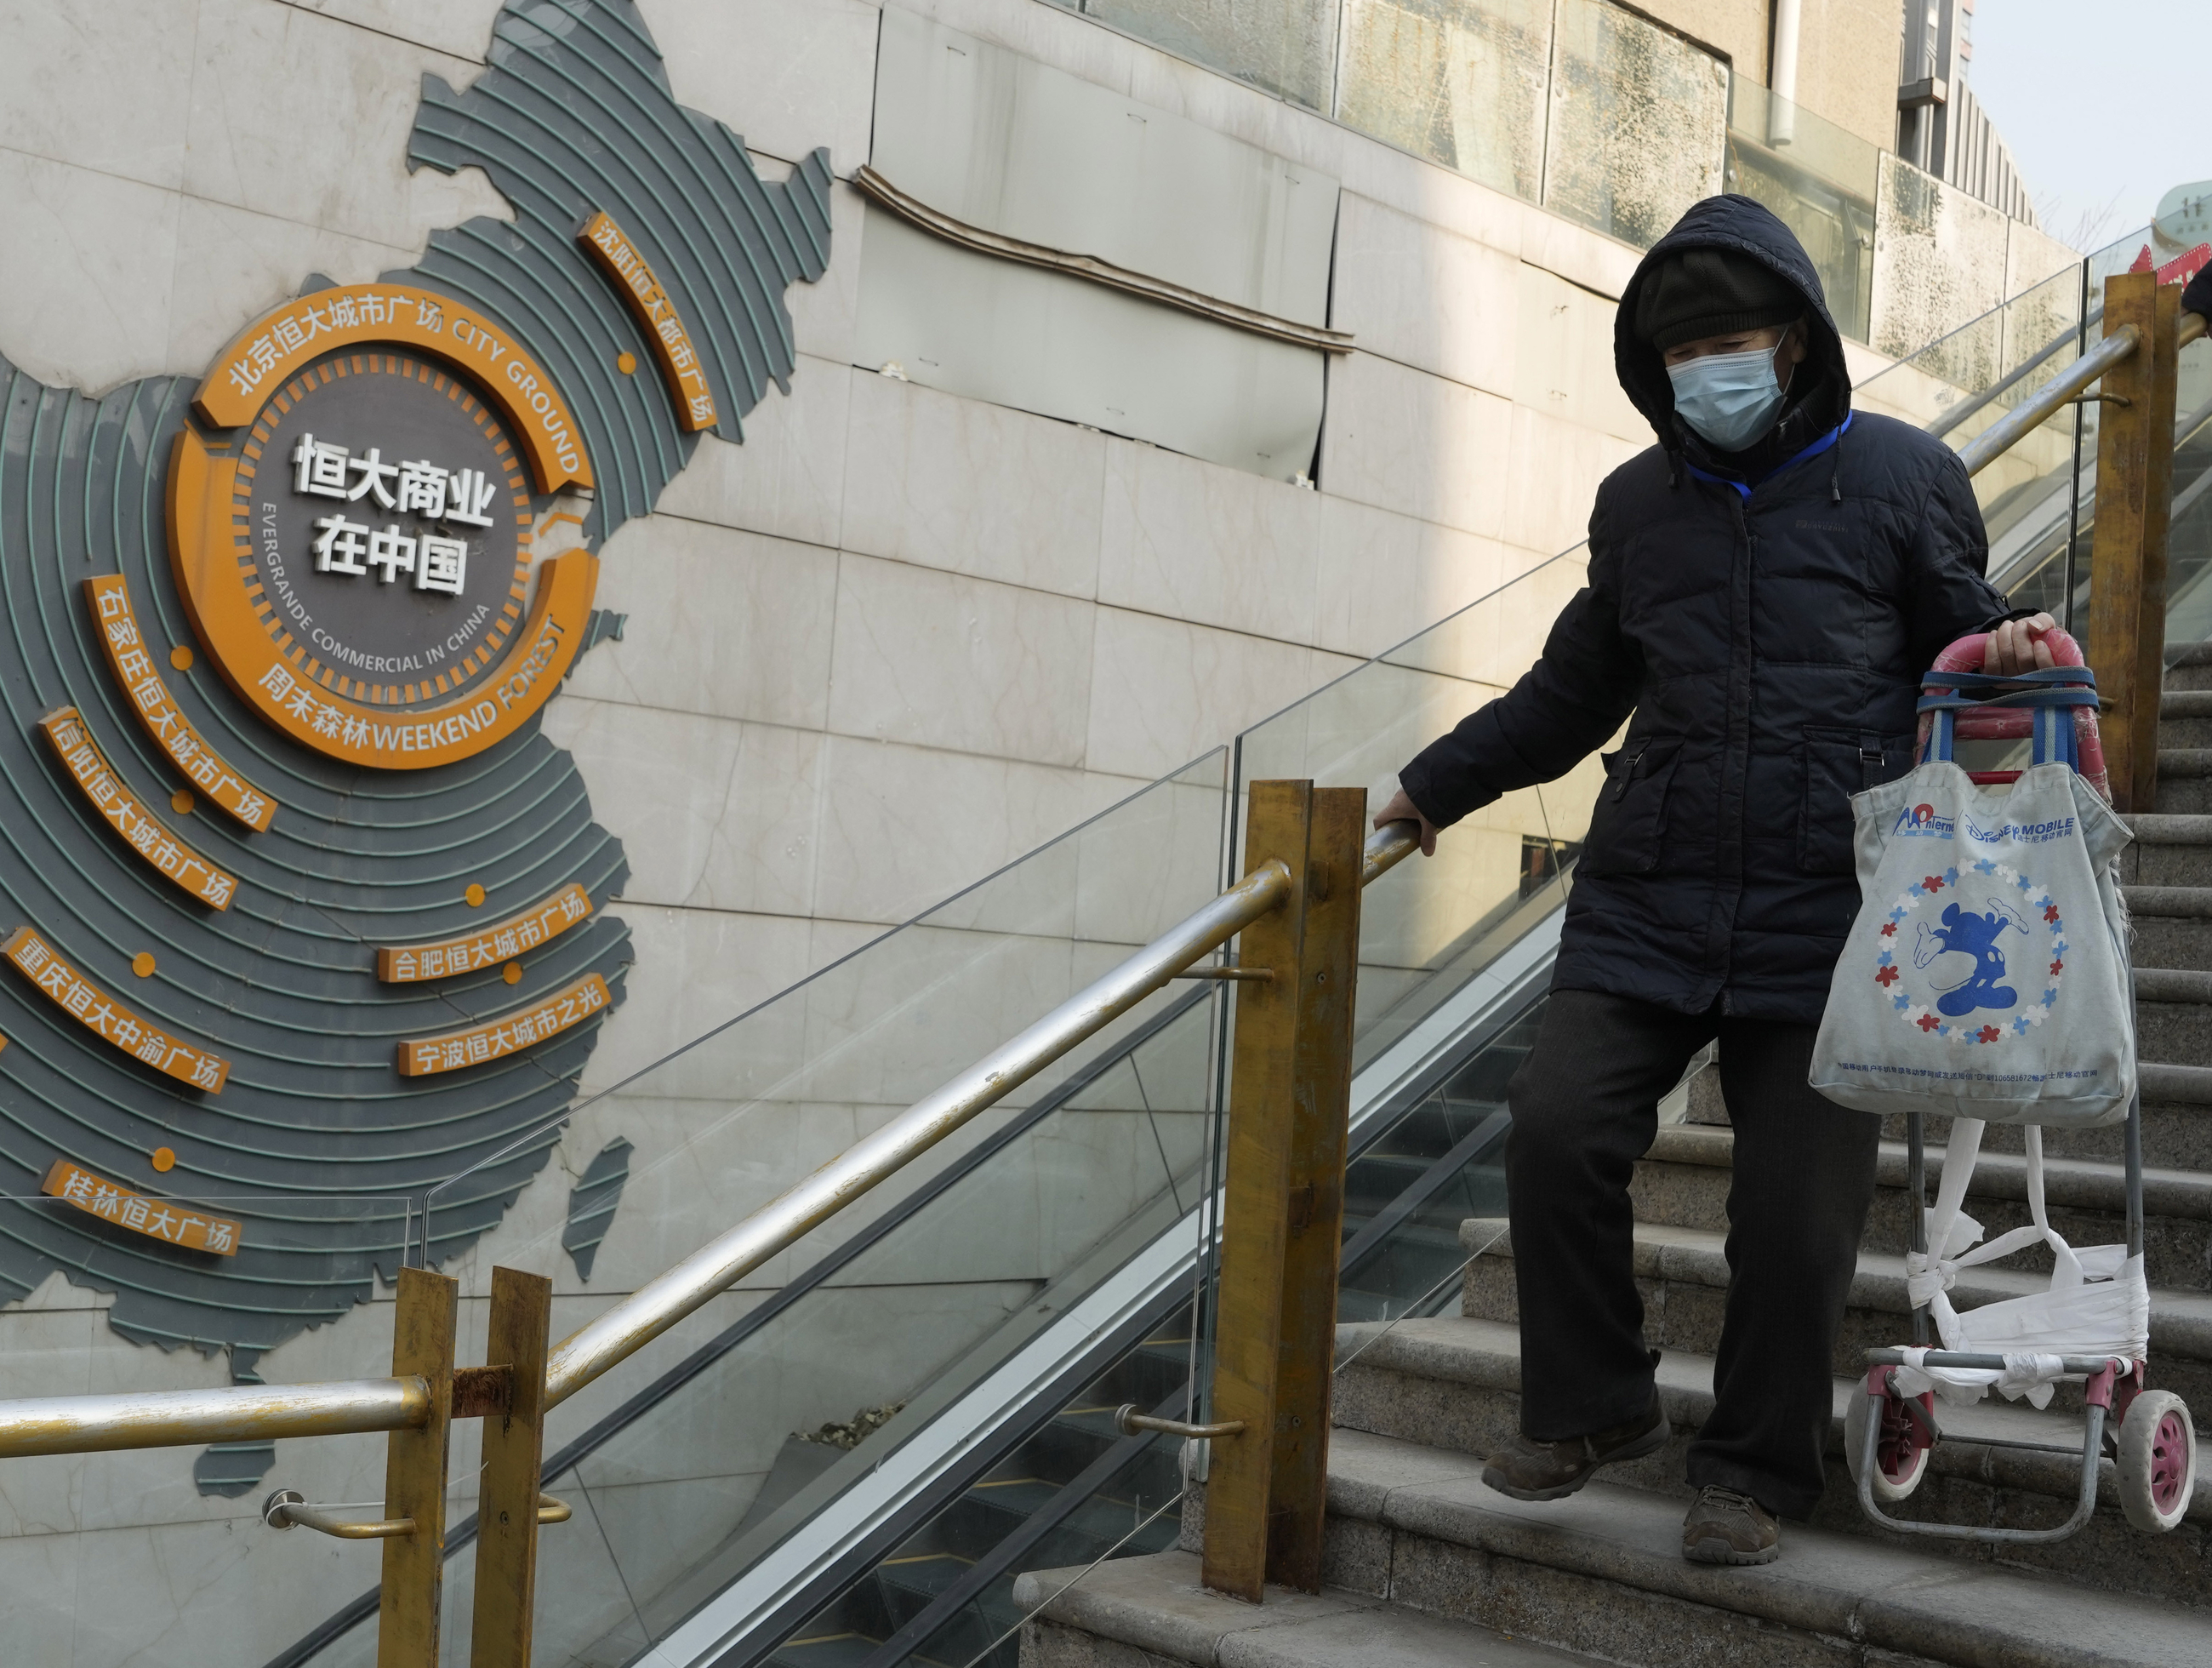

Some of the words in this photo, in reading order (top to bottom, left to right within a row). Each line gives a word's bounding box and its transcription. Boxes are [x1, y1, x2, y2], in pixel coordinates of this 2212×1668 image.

[229, 293, 443, 397] 北京恒大城市广场
[453, 317, 507, 363] CITY
[505, 359, 579, 475] GROUND
[593, 220, 713, 422] 沈阳恒大都市广场
[291, 432, 497, 528] 恒大商业
[261, 502, 313, 631] EVERGRANDE
[311, 626, 424, 673] COMMERCIAL
[425, 645, 445, 665] IN
[447, 603, 491, 653] CHINA
[311, 513, 469, 596] 在中国
[98, 586, 265, 825] 石家庄恒大城市广场
[259, 662, 372, 751] 周末森林
[372, 700, 498, 753] WEEKEND
[497, 614, 567, 710] FOREST
[52, 717, 231, 907] 信阳恒大城市广场
[2021, 817, 2075, 835] MOBILE
[395, 890, 586, 980] 合肥恒大城市广场
[14, 937, 221, 1089] 重庆恒大中渝广场
[416, 983, 602, 1073] 宁波恒大城市之光
[63, 1170, 232, 1253] 桂林恒大广场
